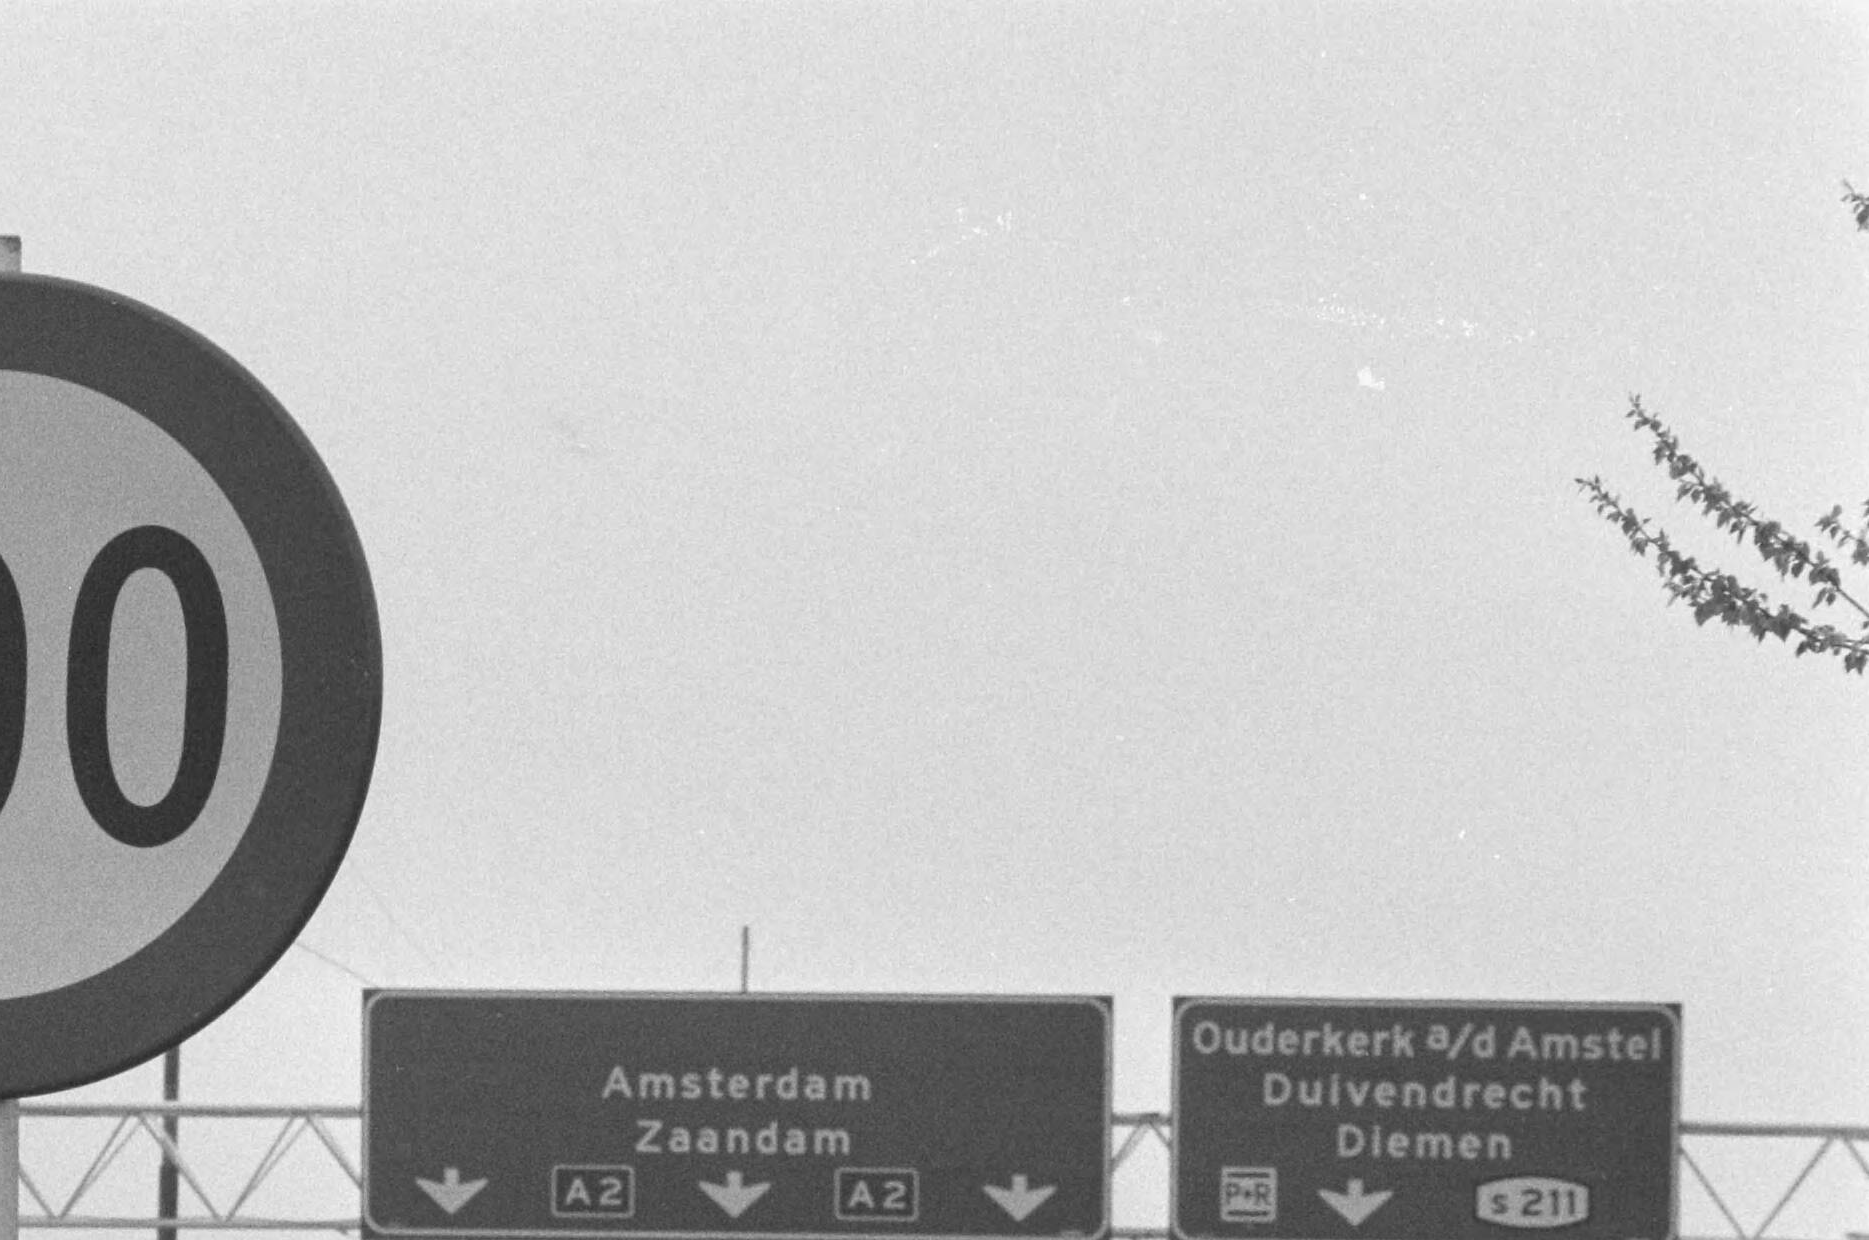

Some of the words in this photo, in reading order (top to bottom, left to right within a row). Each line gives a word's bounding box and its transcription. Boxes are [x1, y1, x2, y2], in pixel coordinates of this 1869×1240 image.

[1192, 1020, 1415, 1058] Ouderkerk
[1428, 1022, 1497, 1061] a/d
[1508, 1026, 1663, 1060] Amstel
[602, 1066, 872, 1101] Amsterdam
[1263, 1072, 1588, 1111] Duivendrecht
[634, 1119, 851, 1155] Zaandam
[1337, 1123, 1513, 1159] Diemen
[564, 1174, 624, 1206] A2
[848, 1178, 907, 1210] A2
[1521, 1187, 1576, 1216] 211
